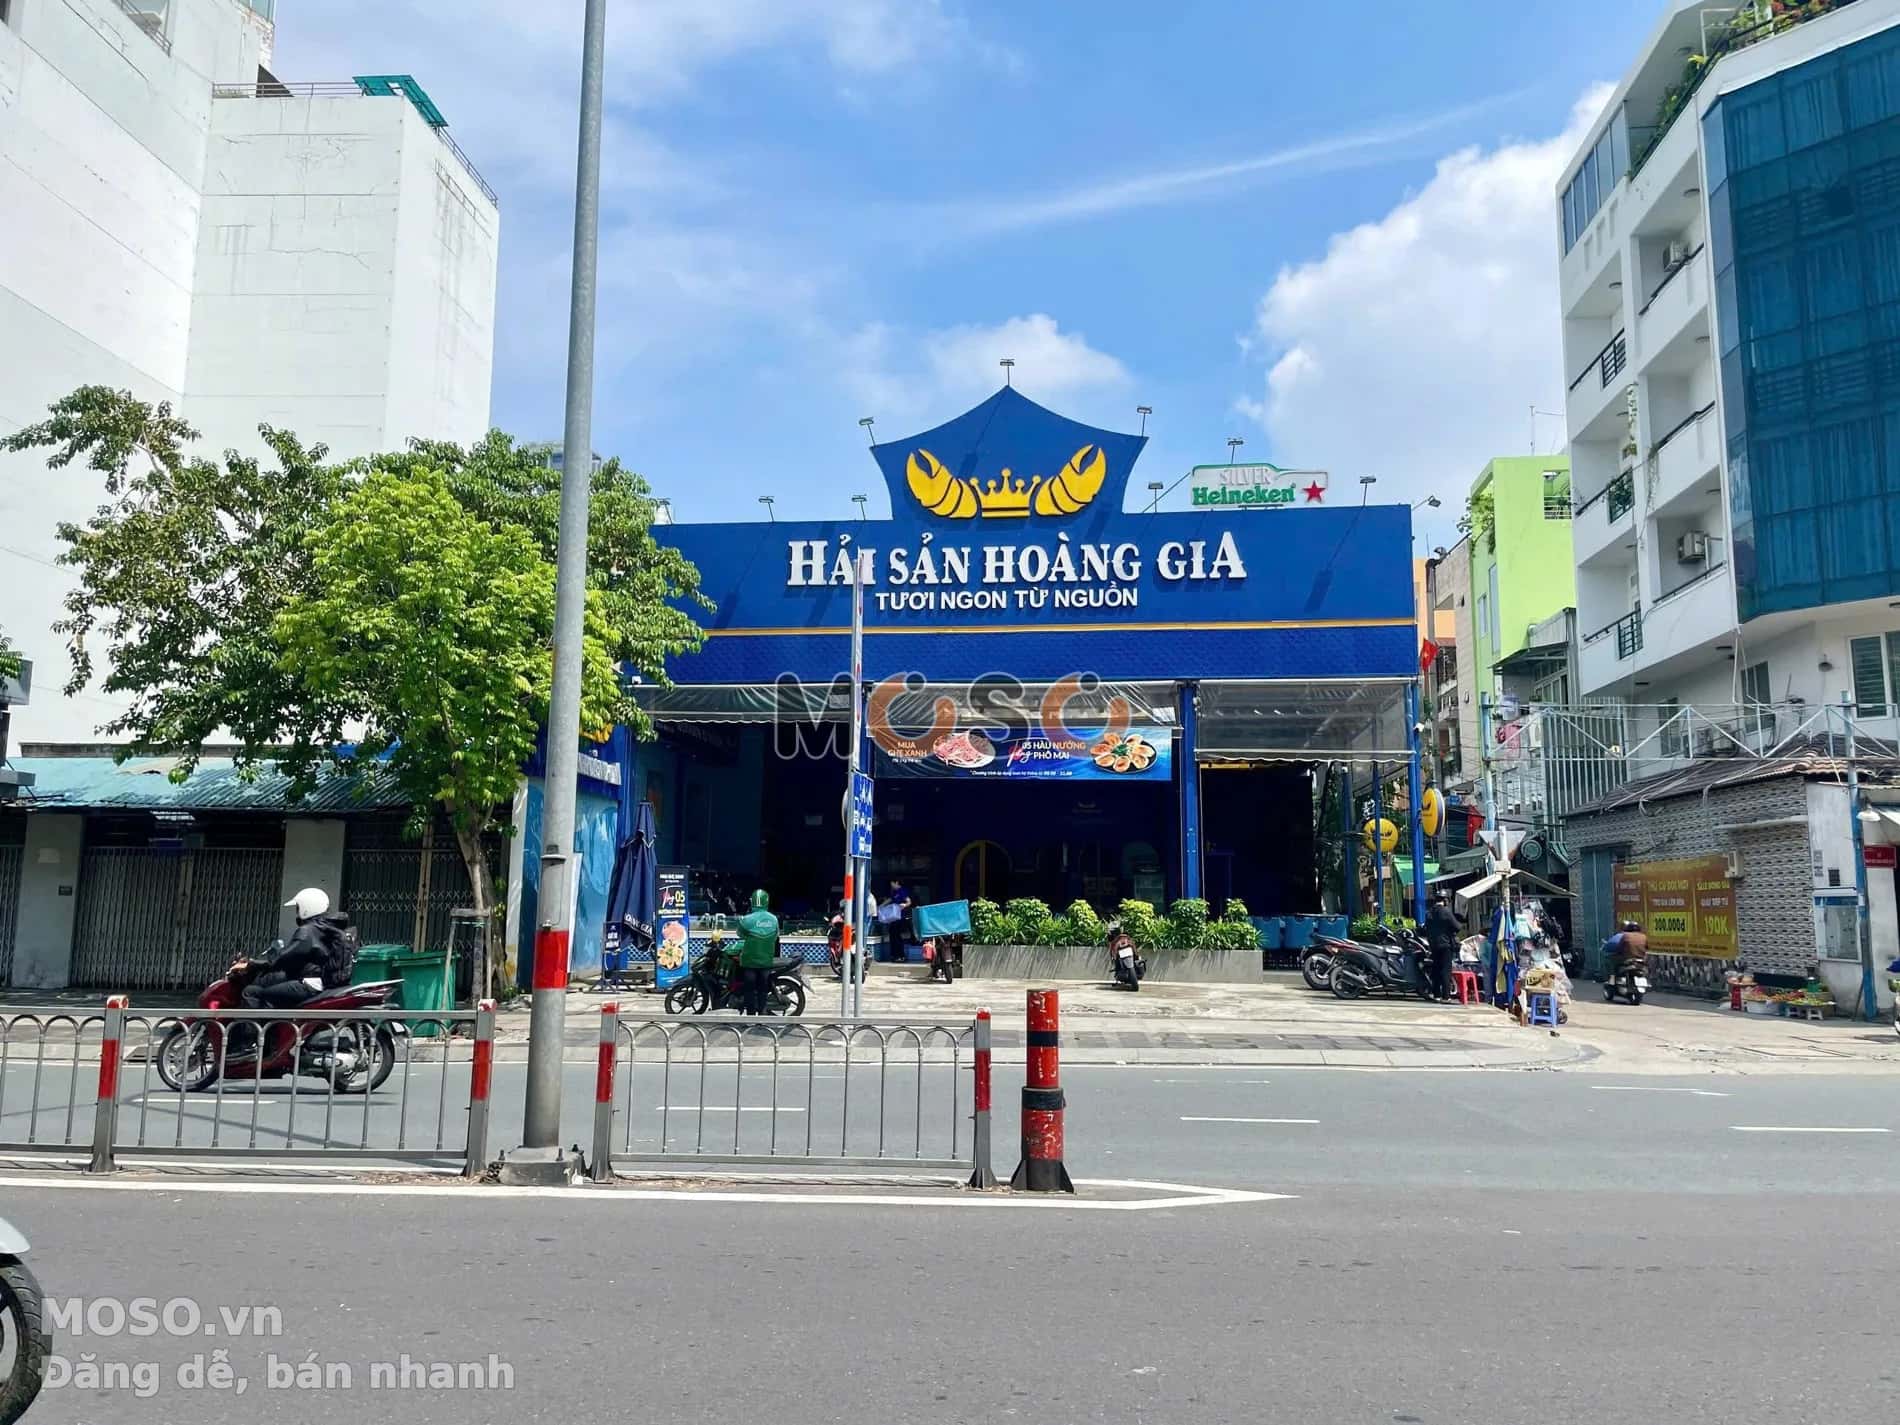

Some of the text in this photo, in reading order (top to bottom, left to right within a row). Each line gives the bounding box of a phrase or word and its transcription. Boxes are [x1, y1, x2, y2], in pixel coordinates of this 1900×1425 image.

[1219, 467, 1273, 486] SILVER
[1191, 483, 1296, 506] Heineken
[787, 531, 1248, 586] HẢI SẢN HOÀNG GIA
[875, 580, 1138, 611] TƯƠI NGON TỪ NGUỒN
[897, 741, 917, 749] MUA
[1053, 751, 1070, 760] MAI
[675, 890, 686, 902] 05
[1704, 916, 1729, 935] 190K
